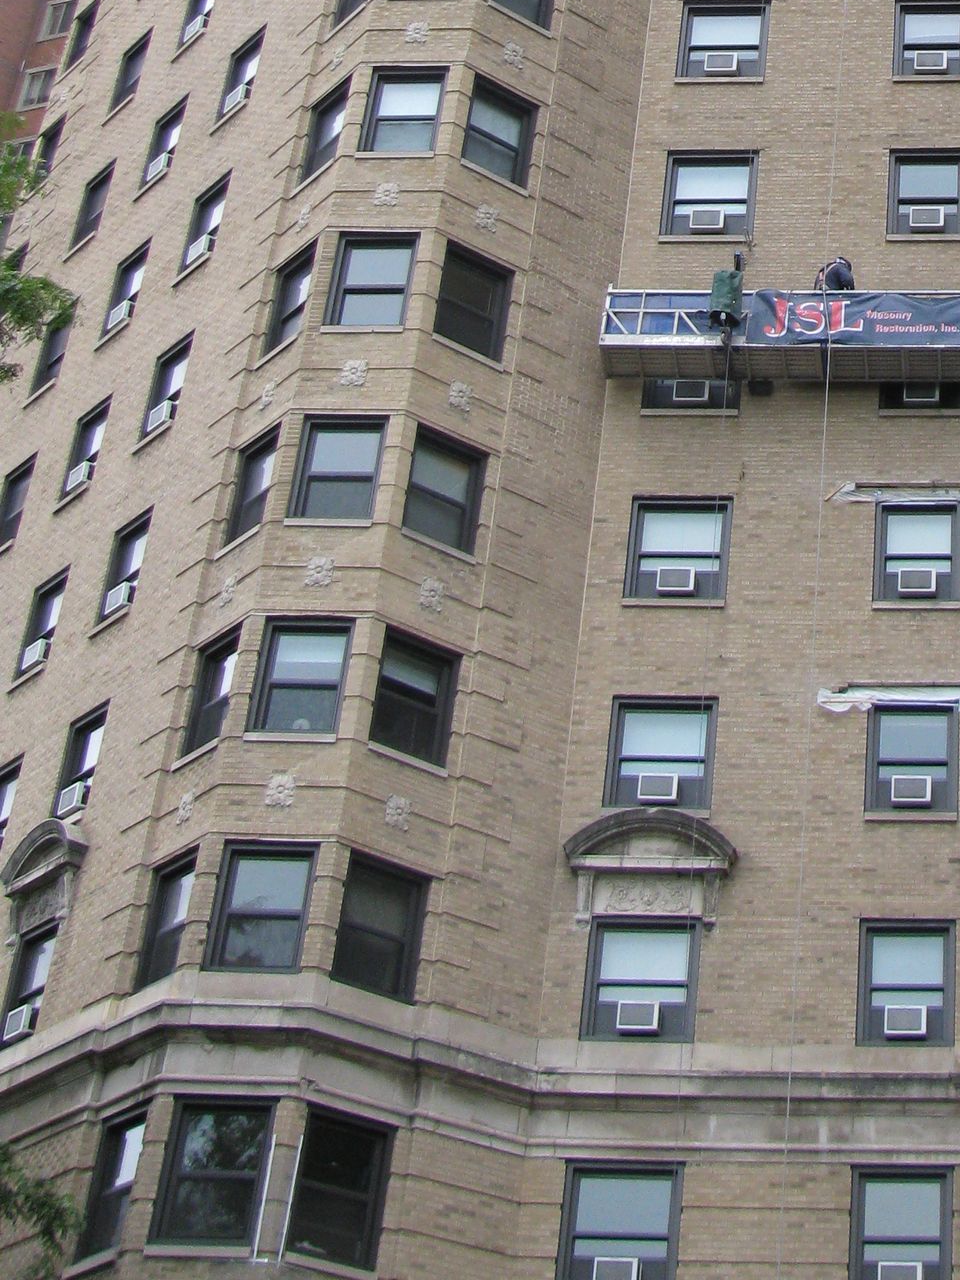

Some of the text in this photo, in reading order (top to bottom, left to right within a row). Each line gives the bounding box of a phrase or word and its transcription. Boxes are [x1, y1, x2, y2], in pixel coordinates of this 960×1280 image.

[763, 297, 864, 337] JSL
[866, 309, 913, 321] Masonry
[875, 323, 960, 333] Restoration, Inc.
